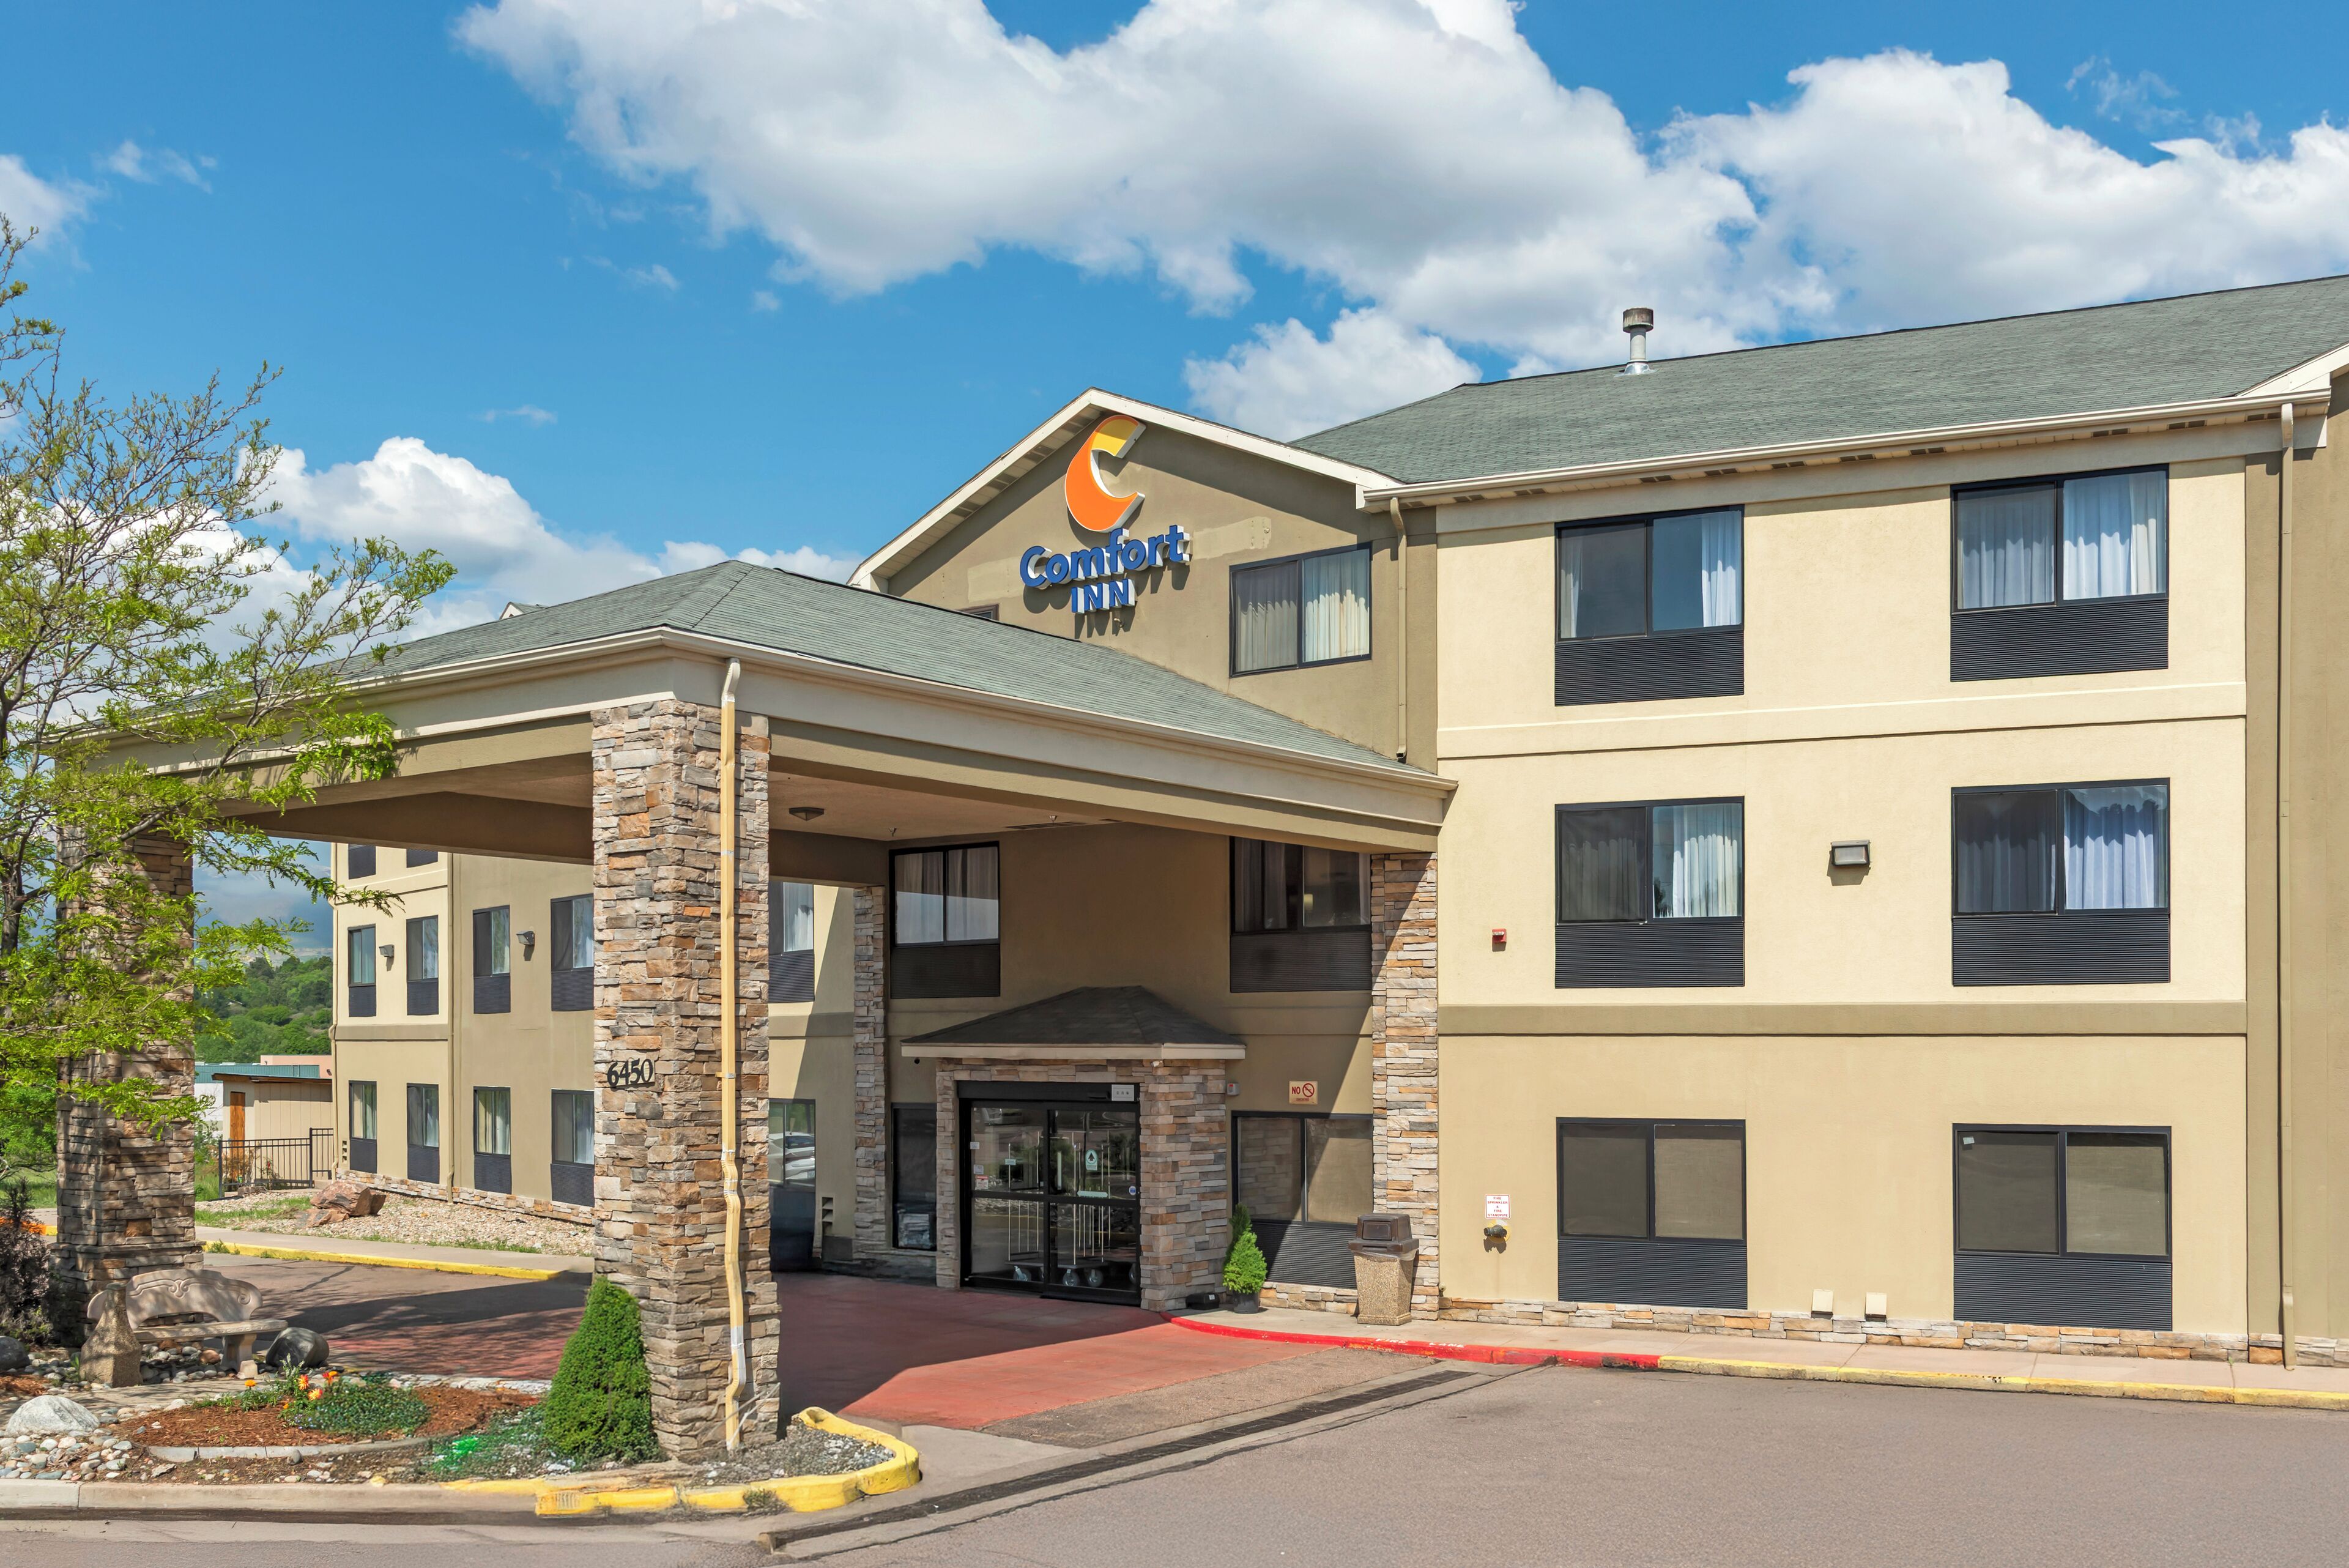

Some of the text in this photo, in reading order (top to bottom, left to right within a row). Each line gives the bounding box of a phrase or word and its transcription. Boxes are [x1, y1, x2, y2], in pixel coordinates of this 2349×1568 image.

[1020, 524, 1189, 589] Comfort
[1071, 578, 1135, 614] INN
[607, 1058, 653, 1087] 6450
